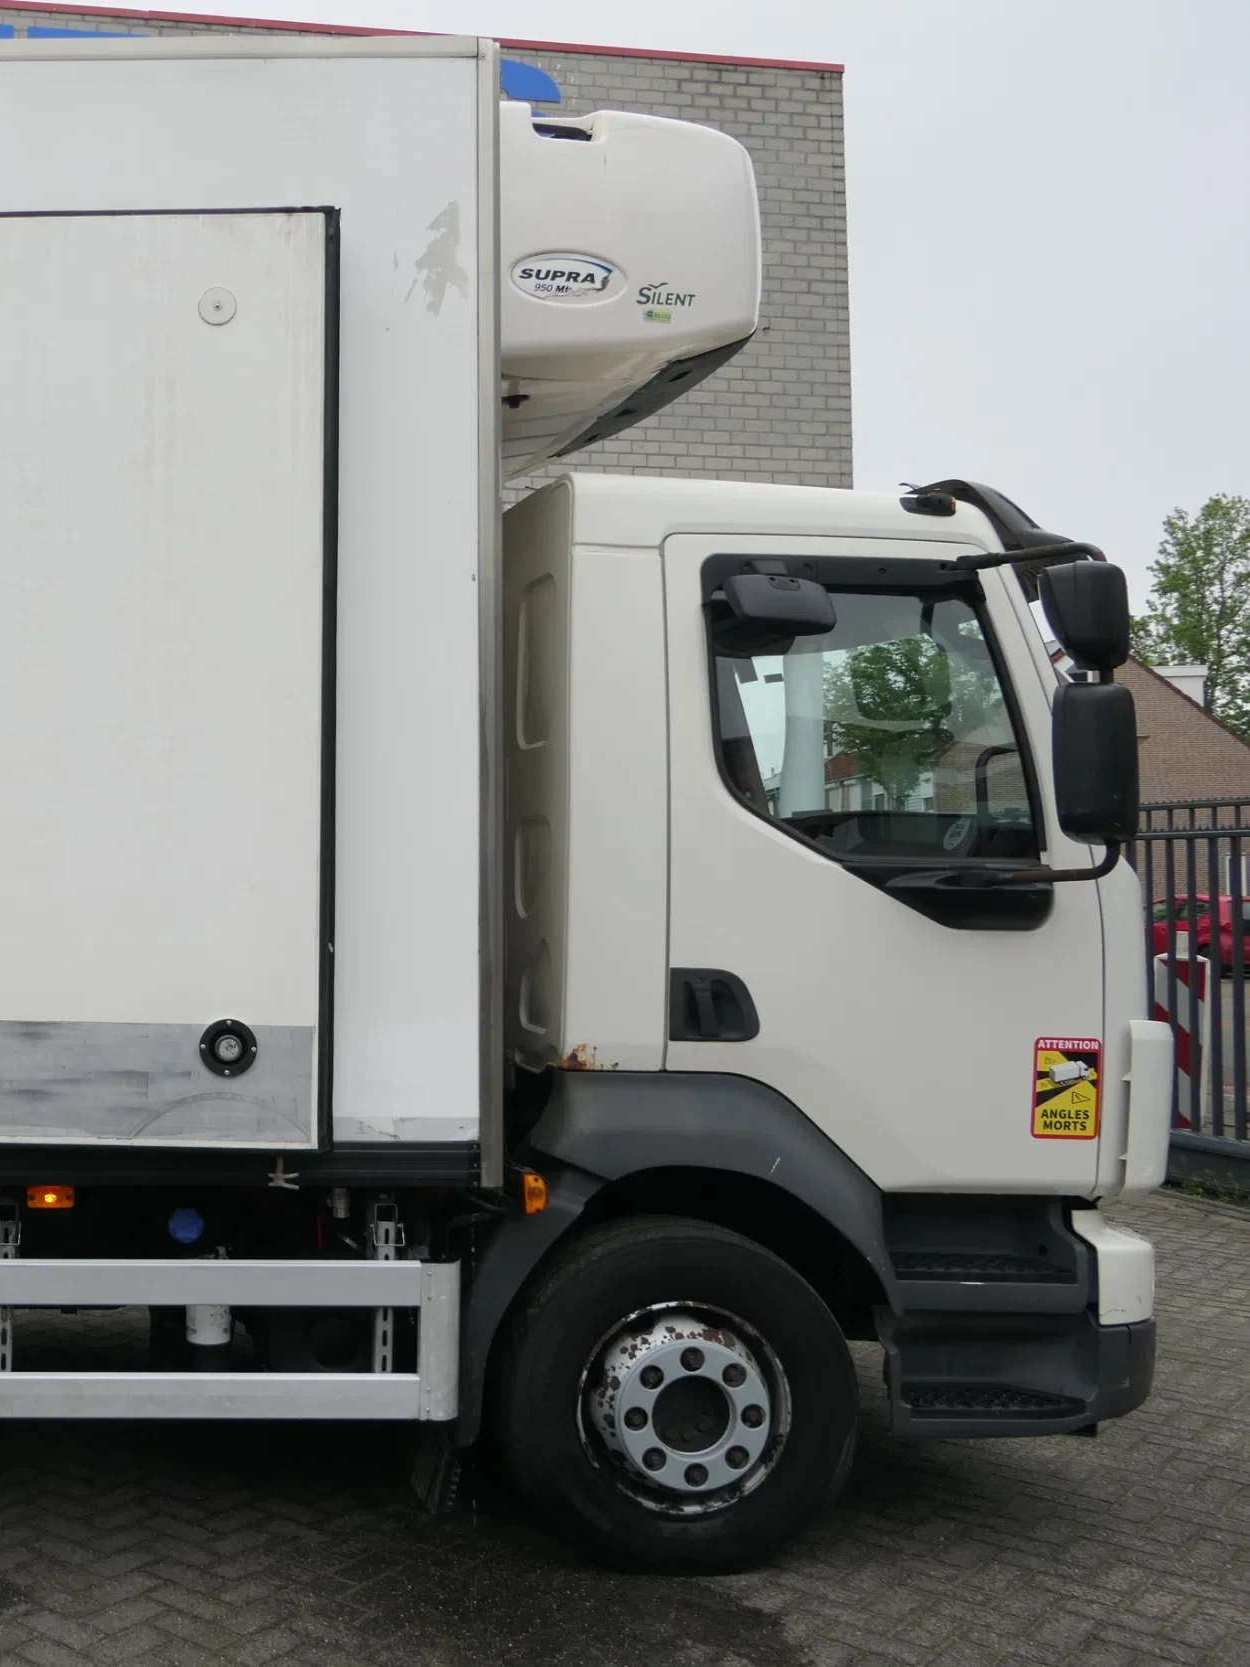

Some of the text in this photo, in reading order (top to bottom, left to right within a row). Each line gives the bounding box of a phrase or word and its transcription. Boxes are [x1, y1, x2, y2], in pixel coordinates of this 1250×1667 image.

[518, 268, 595, 284] SUPRA
[534, 283, 553, 292] 950
[1037, 1040, 1099, 1050] ATTENTION
[1041, 1109, 1090, 1120] ANGLES
[1043, 1120, 1087, 1131] MORTS
